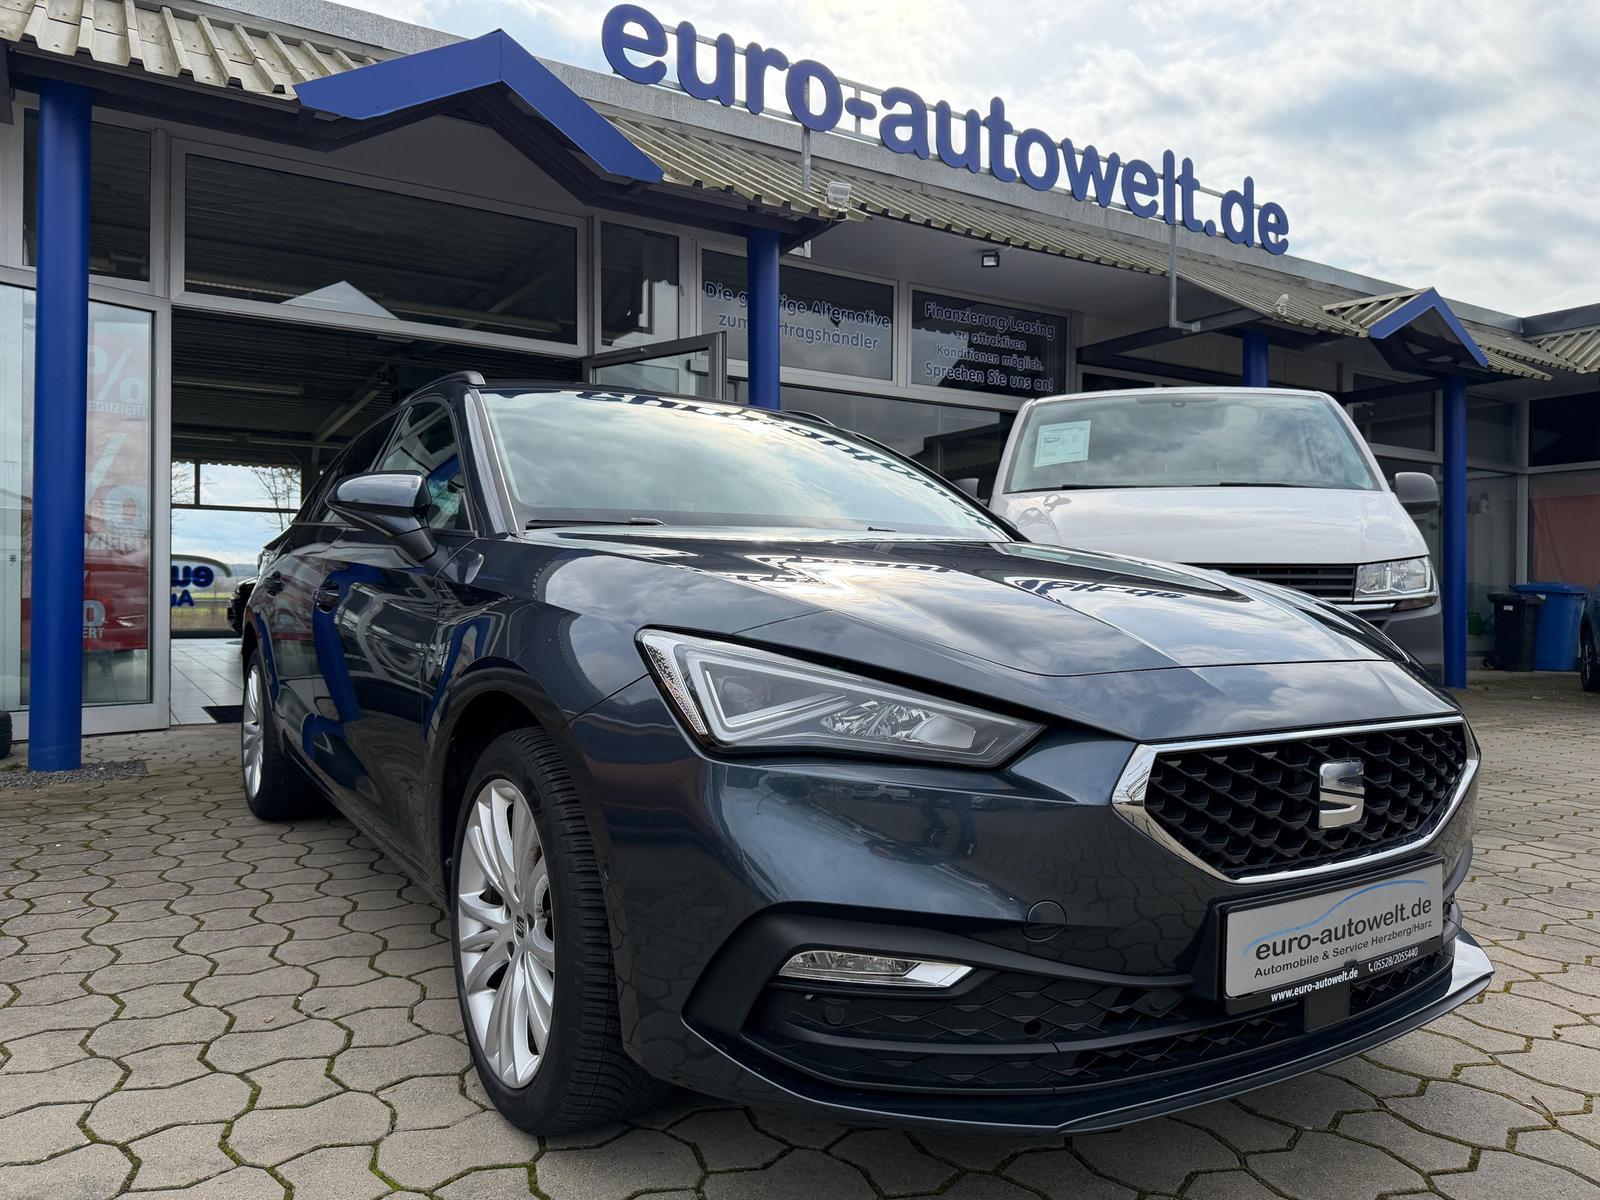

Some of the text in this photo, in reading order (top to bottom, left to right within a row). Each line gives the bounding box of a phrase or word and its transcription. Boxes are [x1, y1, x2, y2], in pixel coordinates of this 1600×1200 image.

[602, 4, 1289, 255] euro-autowelt.de
[704, 281, 891, 329] Die gige Alternative
[924, 301, 1055, 341] Finanzierung/Leasing
[780, 320, 879, 350] tragshändler
[955, 330, 1026, 351] zu attraktiven
[937, 344, 1044, 371] Konditionen möglich.
[924, 360, 1054, 393] Sprechen Sie uns an!
[1256, 897, 1432, 960] euro-autowelt.de
[1254, 920, 1432, 978] Automobile & Service Herzberg/Harz
[1271, 968, 1359, 1002] www.euro-autowelt.de
